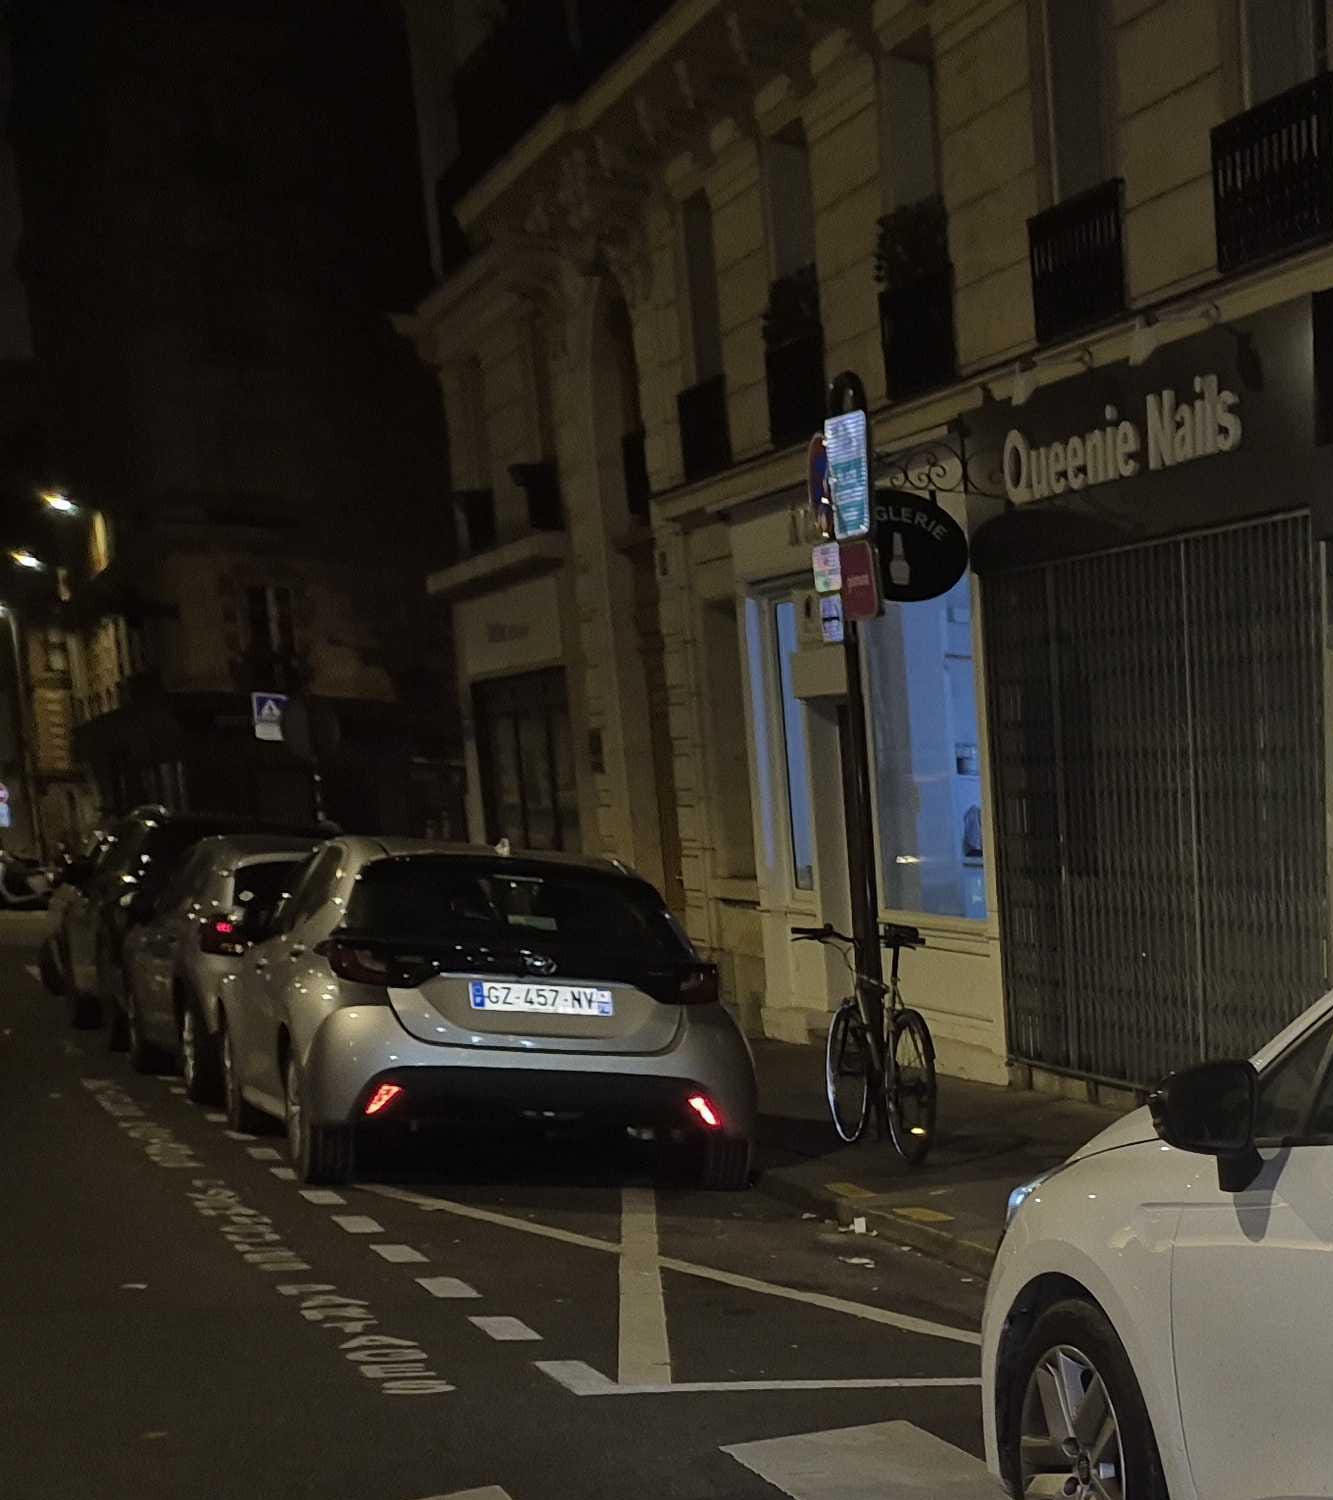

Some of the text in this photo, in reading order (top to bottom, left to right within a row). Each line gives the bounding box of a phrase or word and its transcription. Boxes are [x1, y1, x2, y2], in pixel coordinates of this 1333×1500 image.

[1003, 374, 1243, 506] Queenie Nails
[876, 506, 950, 542] GLERIE
